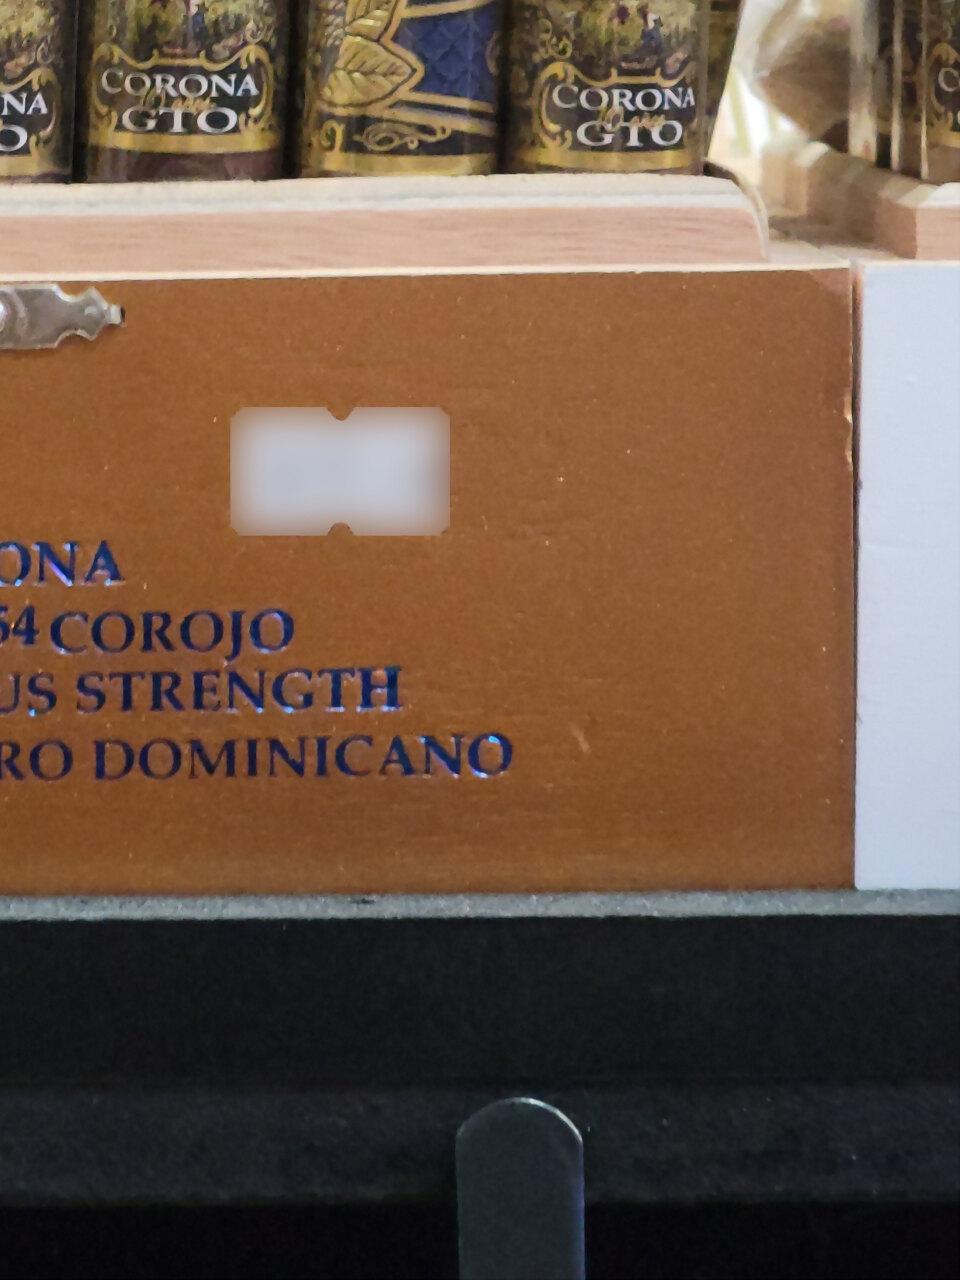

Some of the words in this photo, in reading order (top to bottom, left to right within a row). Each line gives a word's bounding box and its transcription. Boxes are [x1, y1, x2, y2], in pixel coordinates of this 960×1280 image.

[101, 66, 259, 99] CORONA
[551, 82, 696, 112] CORONA
[121, 104, 239, 134] GTO
[575, 119, 684, 148] GTO
[49, 607, 296, 664] COROJO
[75, 665, 404, 715] STRENGTH
[92, 731, 515, 781] DOMINICANO
